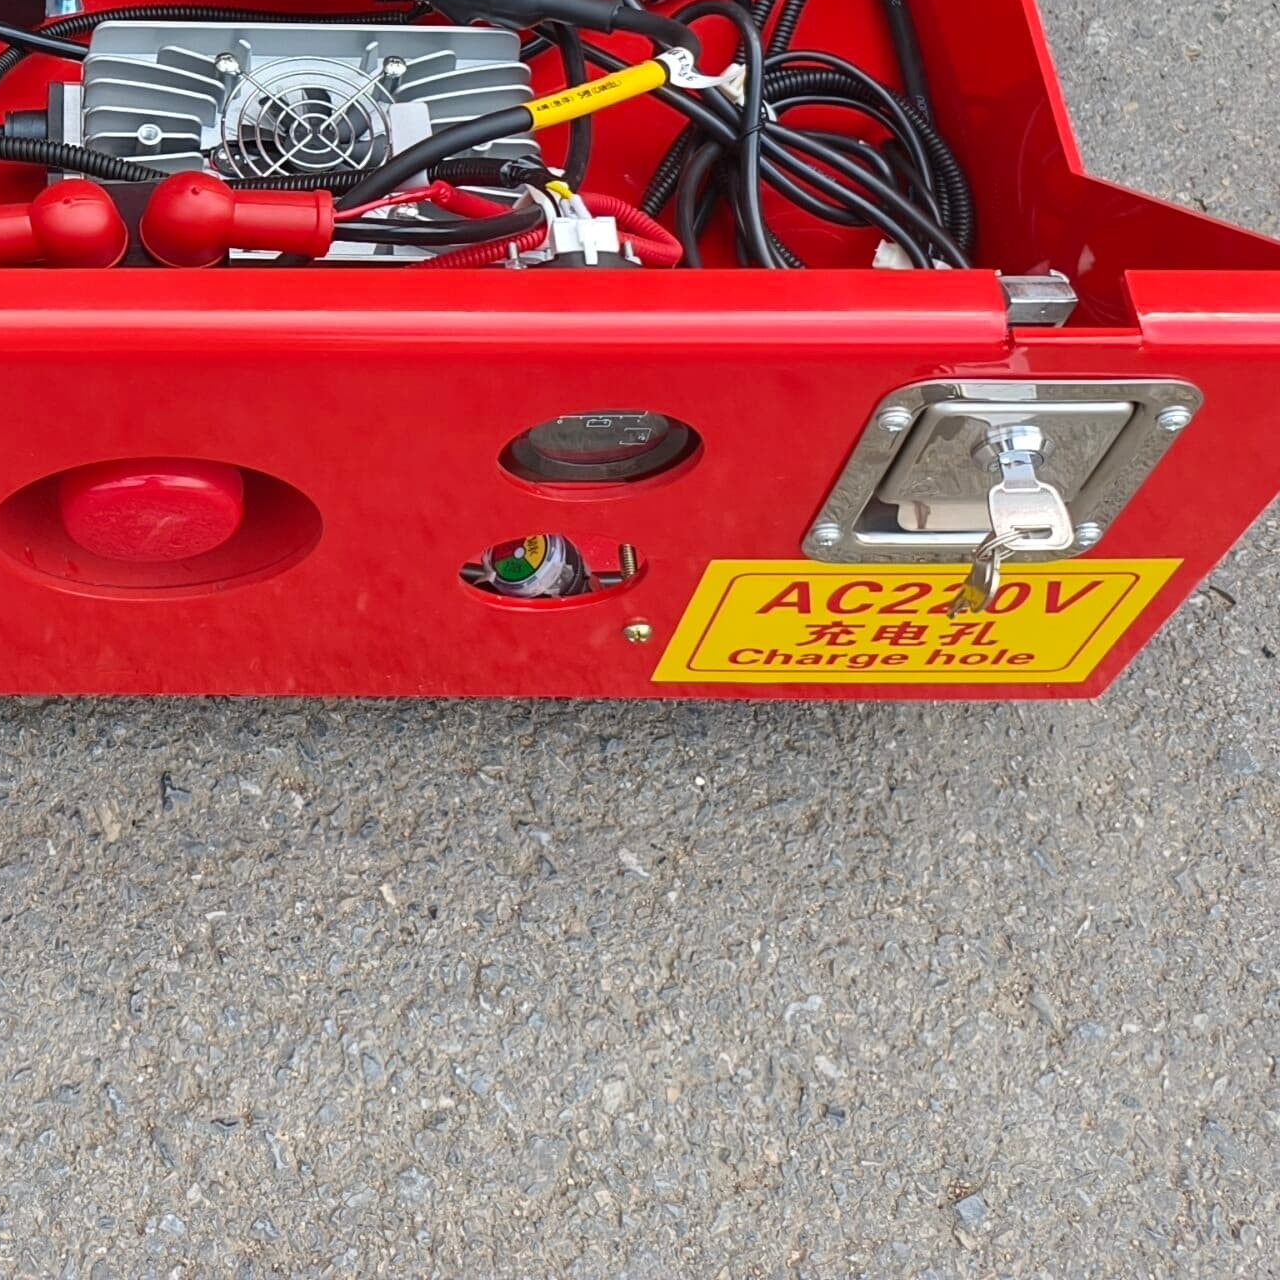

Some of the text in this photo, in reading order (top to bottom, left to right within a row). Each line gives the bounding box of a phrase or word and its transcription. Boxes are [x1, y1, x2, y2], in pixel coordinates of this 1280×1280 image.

[794, 620, 1000, 648] 充电孔
[727, 648, 1037, 670] Charge hole
